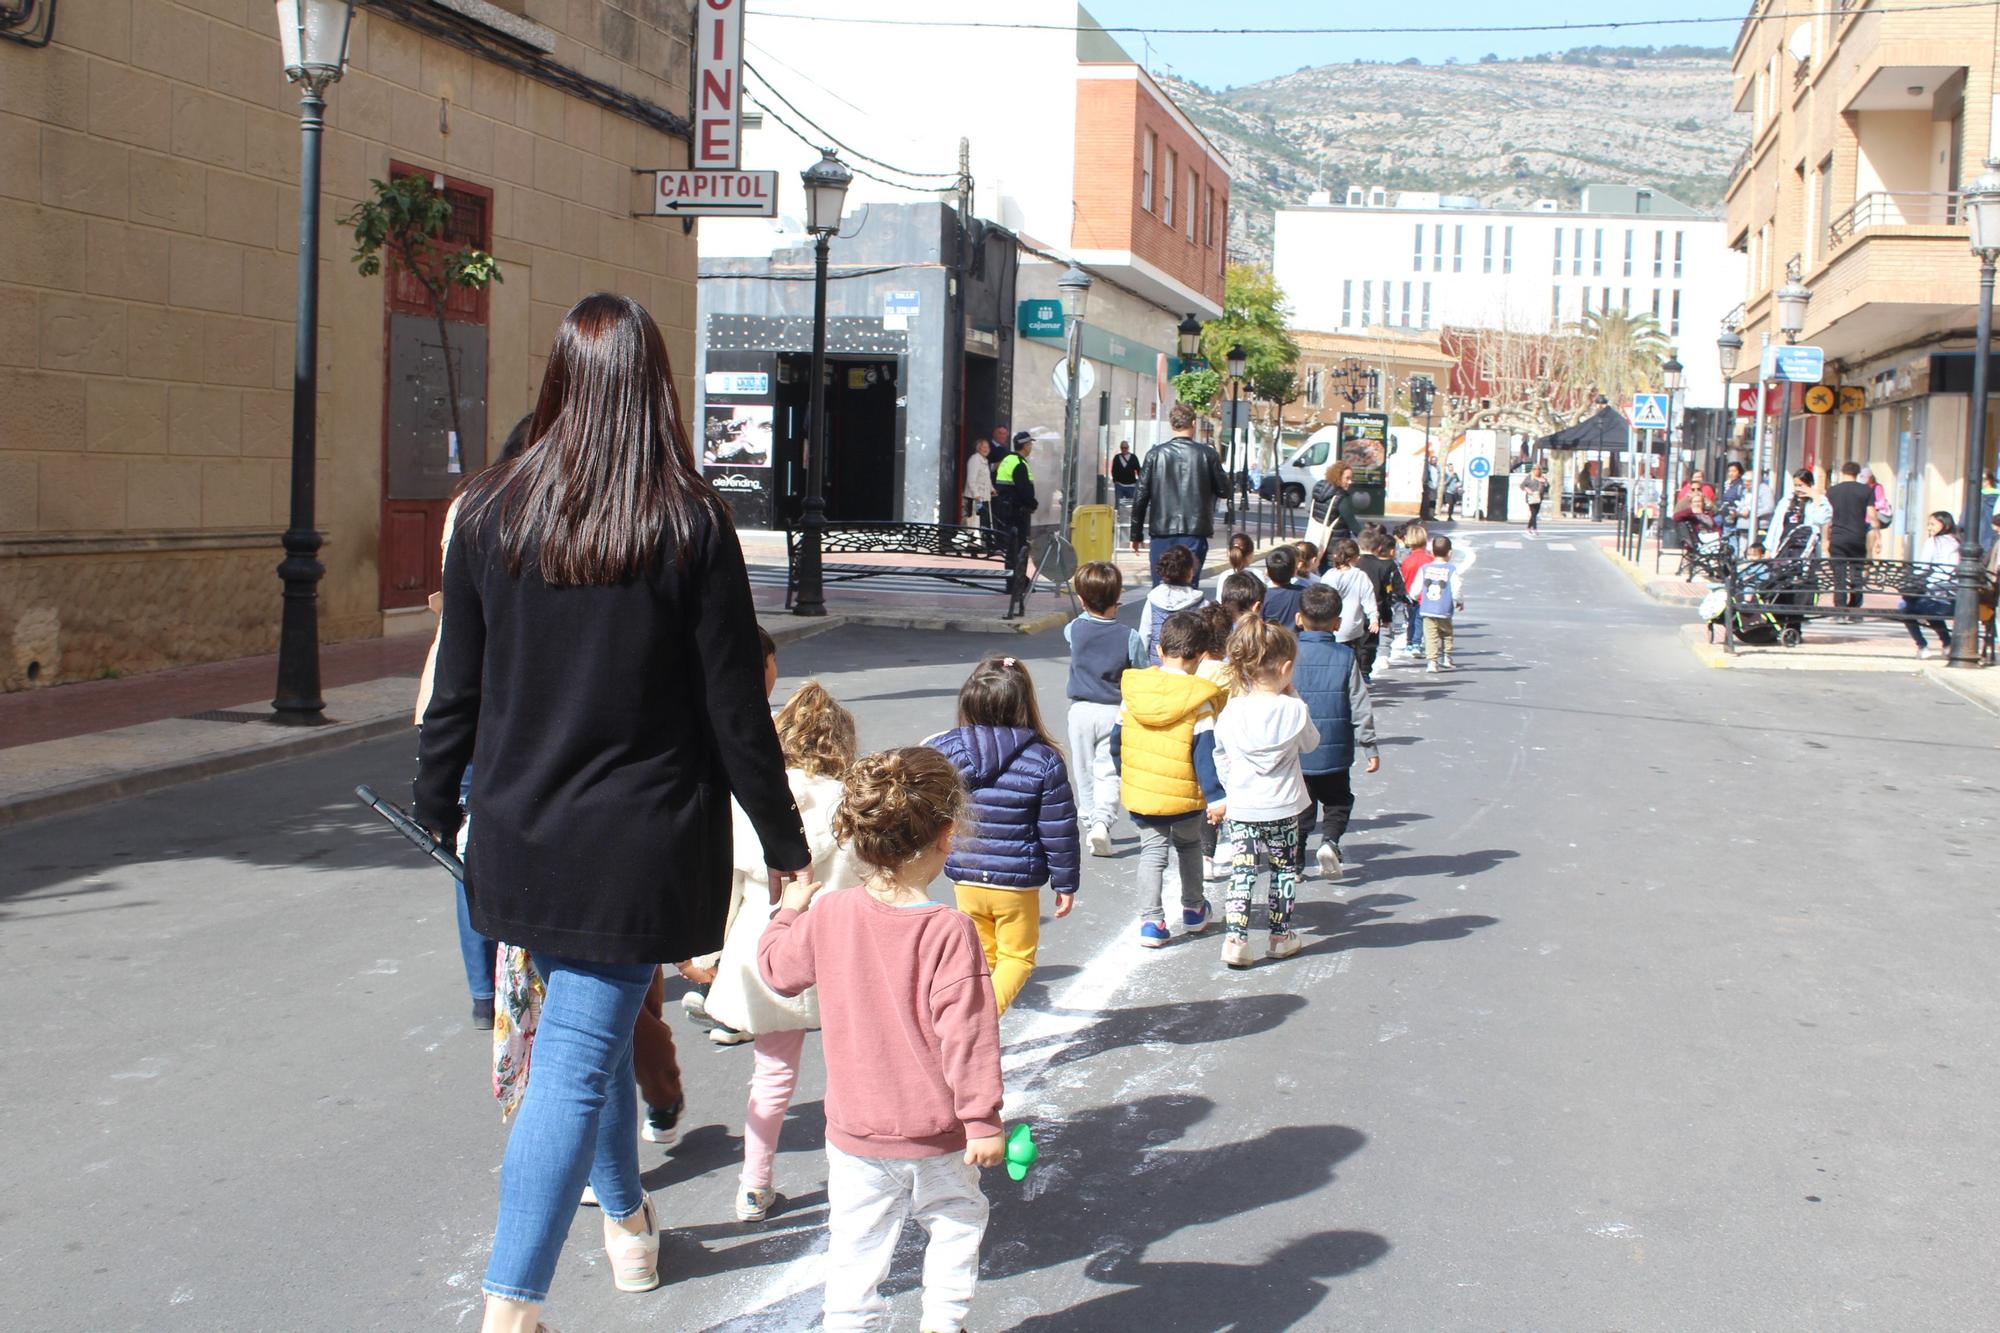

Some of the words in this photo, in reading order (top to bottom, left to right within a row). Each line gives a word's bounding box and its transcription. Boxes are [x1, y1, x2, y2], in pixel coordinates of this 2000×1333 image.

[701, 0, 733, 160] INE
[660, 175, 768, 198] CAPITOL
[1028, 321, 1062, 331] cajamar
